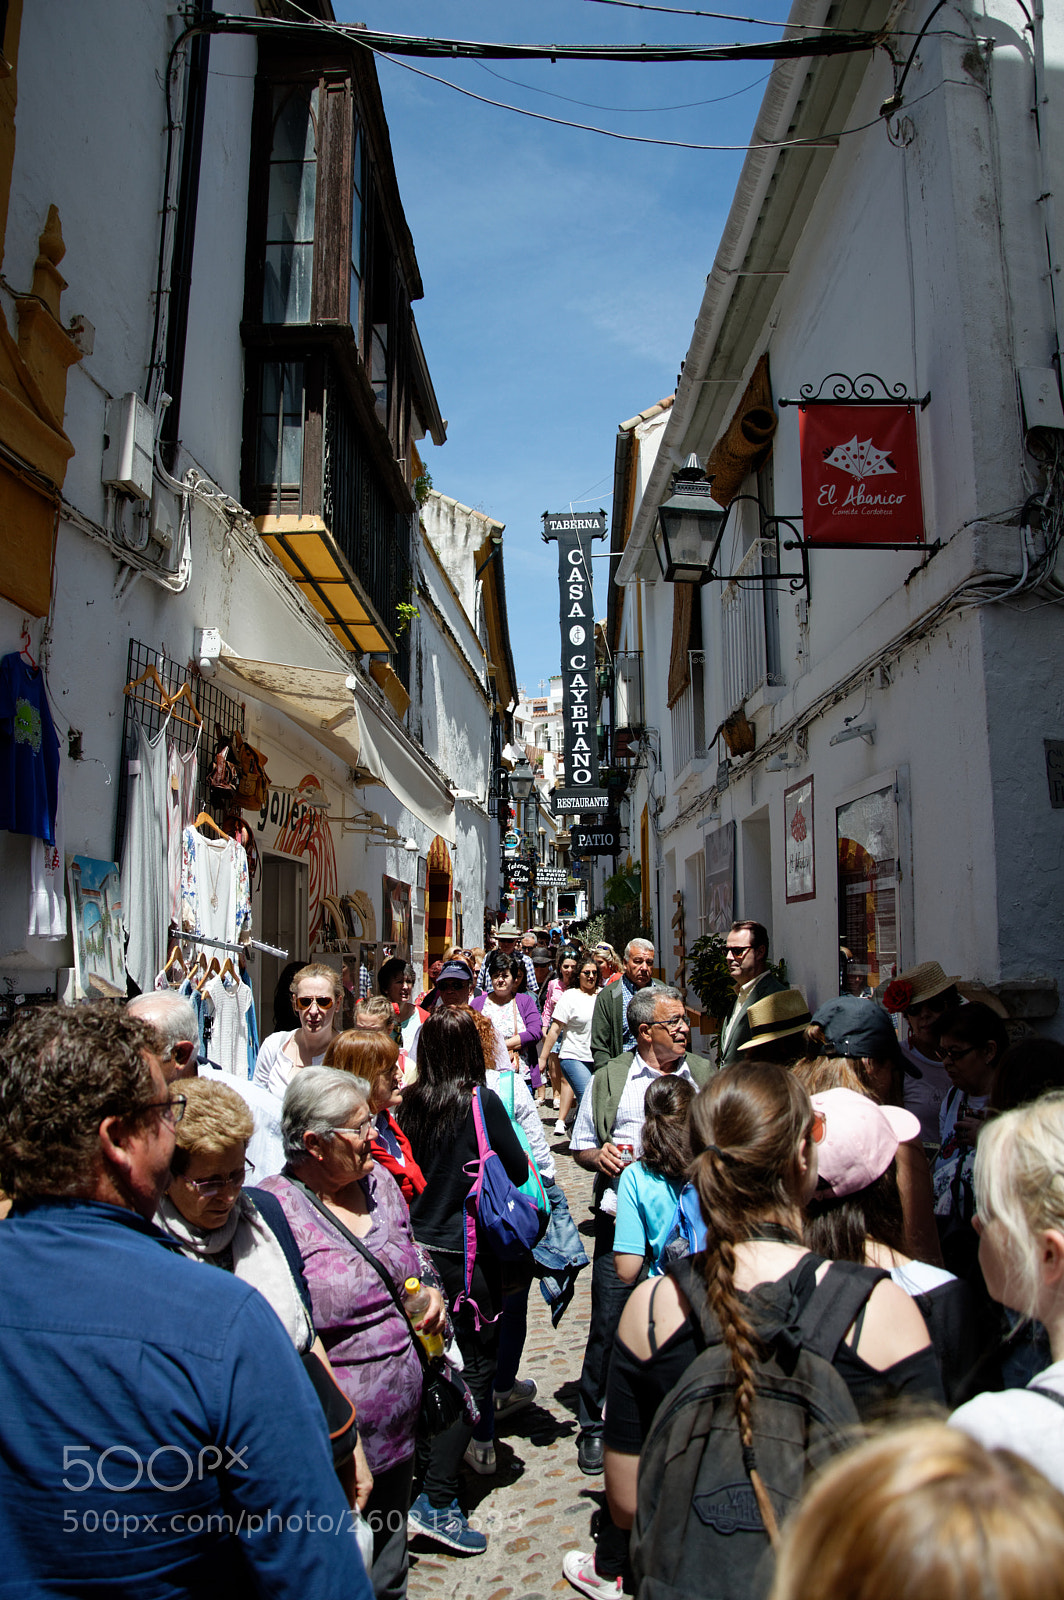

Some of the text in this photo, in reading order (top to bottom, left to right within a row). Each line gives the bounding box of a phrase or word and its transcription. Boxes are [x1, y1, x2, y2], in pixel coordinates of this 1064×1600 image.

[817, 483, 907, 507] El Abanico
[550, 519, 600, 531] TABERNA
[567, 549, 586, 618] CASA
[570, 655, 592, 784] CAYETANO
[556, 796, 609, 809] RESTAURANTE
[257, 789, 317, 850] gallery
[577, 833, 614, 848] PATIO
